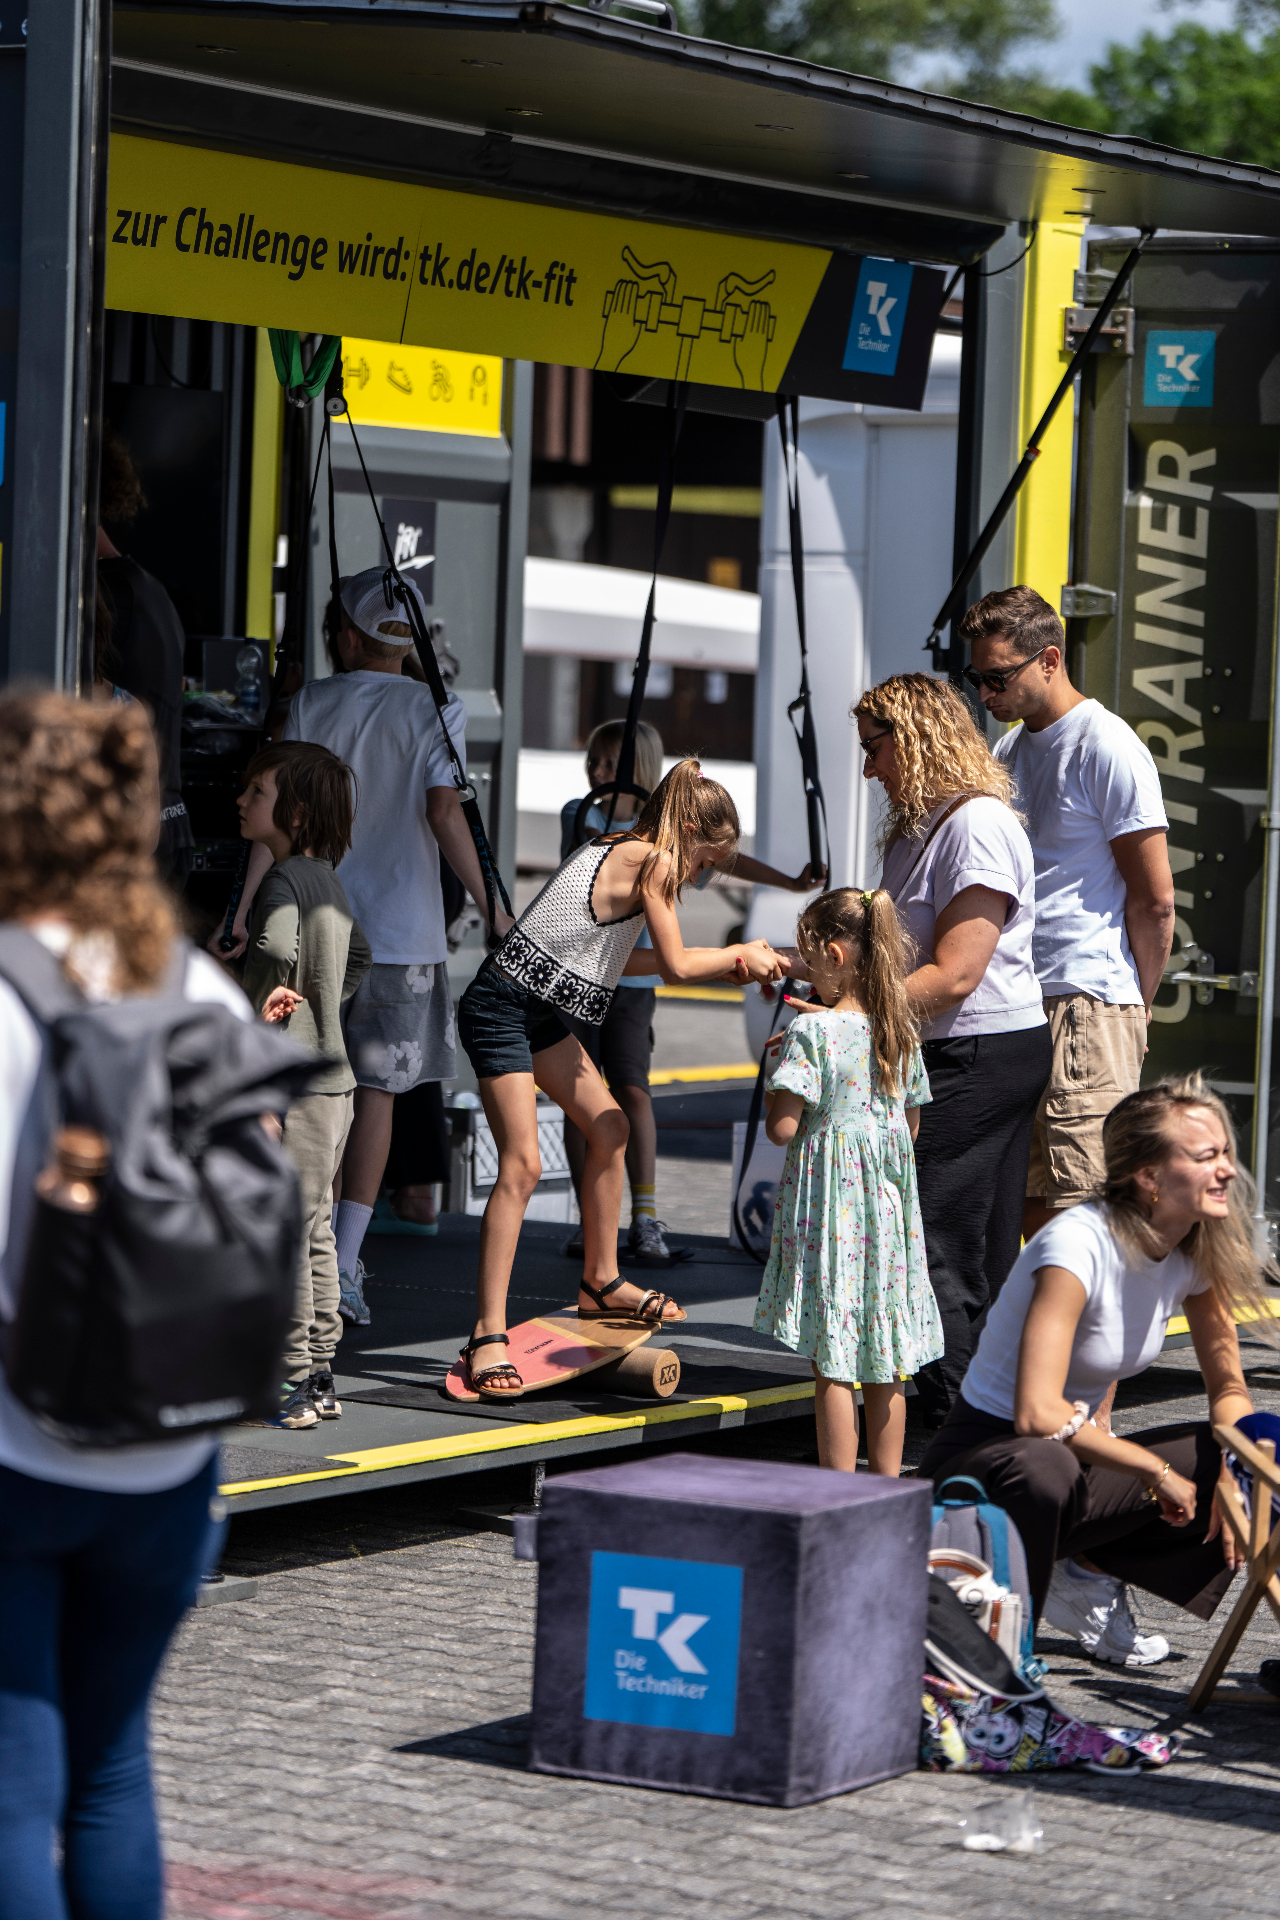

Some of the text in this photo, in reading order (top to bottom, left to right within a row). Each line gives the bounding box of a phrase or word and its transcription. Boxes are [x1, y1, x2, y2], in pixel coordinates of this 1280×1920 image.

[112, 206, 578, 307] zur Challenge wird: tk.de/tk-fit
[866, 280, 898, 337] TK
[858, 322, 872, 336] Die
[857, 336, 891, 353] Techniker
[1157, 345, 1201, 382] TK
[1157, 373, 1173, 383] Die
[1157, 383, 1201, 393] Techniker
[618, 1585, 711, 1676] TK
[614, 1649, 648, 1672] Die
[614, 1669, 710, 1700] Techniker
